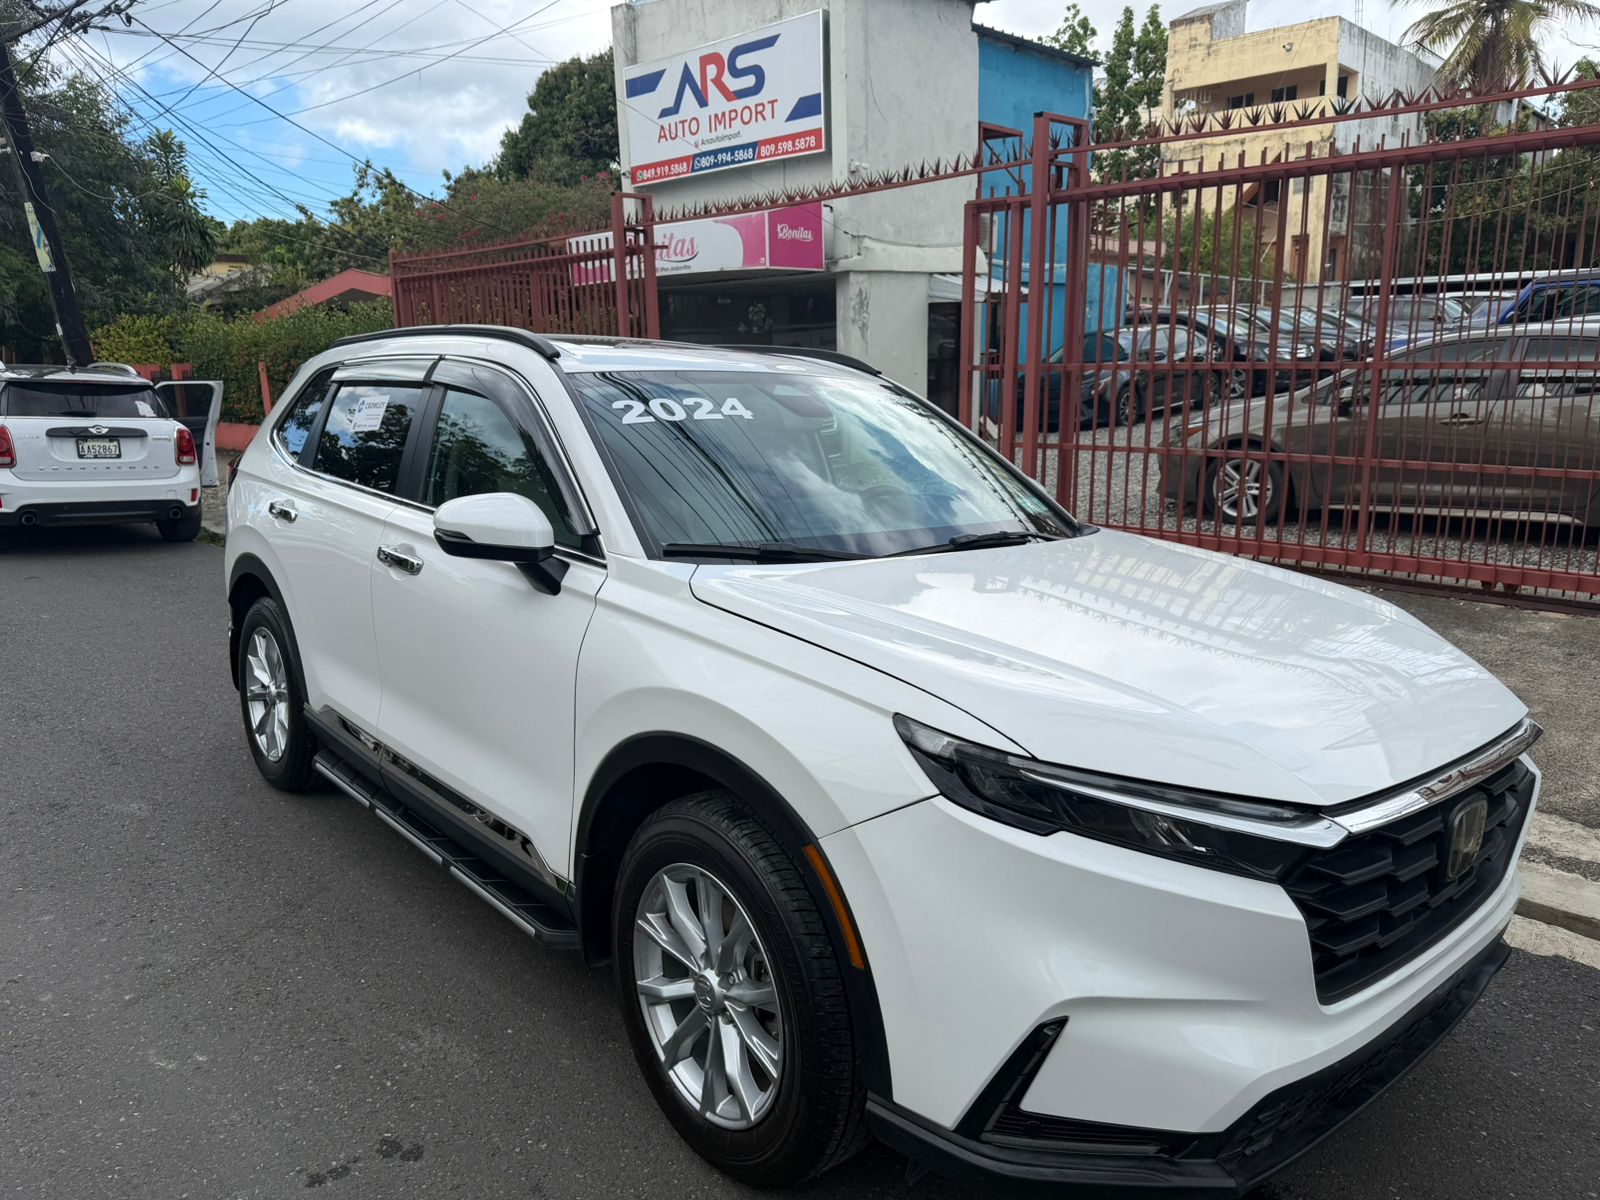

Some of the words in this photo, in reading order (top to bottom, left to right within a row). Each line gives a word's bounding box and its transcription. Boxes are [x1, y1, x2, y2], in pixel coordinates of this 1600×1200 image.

[657, 32, 782, 120] ARS
[657, 116, 700, 144] AUTO
[708, 98, 779, 134] IMPORT
[700, 147, 753, 168] 809-994-5868
[760, 135, 816, 158] 809.598.5878
[776, 222, 814, 242] Bonitas
[611, 396, 755, 425] 2024
